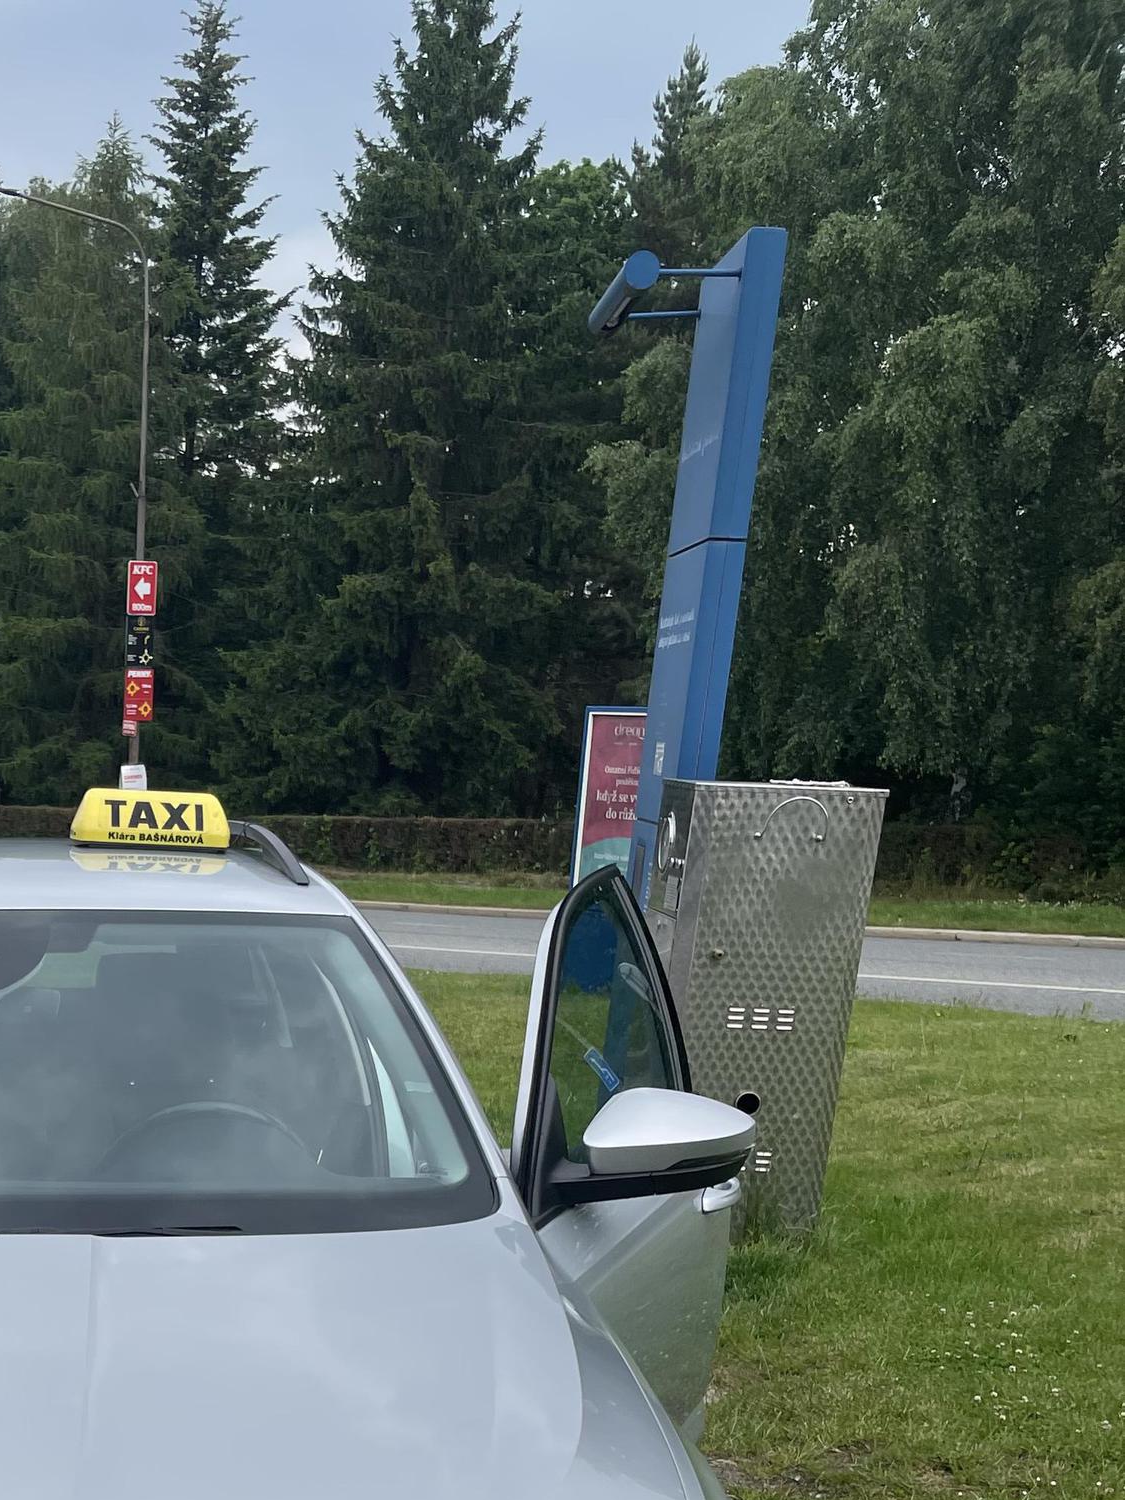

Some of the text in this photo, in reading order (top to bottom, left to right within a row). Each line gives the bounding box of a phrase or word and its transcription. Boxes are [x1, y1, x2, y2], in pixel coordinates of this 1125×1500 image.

[132, 565, 154, 575] KFC
[596, 789, 617, 804] když
[618, 793, 629, 803] se
[104, 799, 204, 832] TAXI
[606, 807, 617, 819] do
[108, 831, 204, 845] Klára BAŠNÁROVÁ
